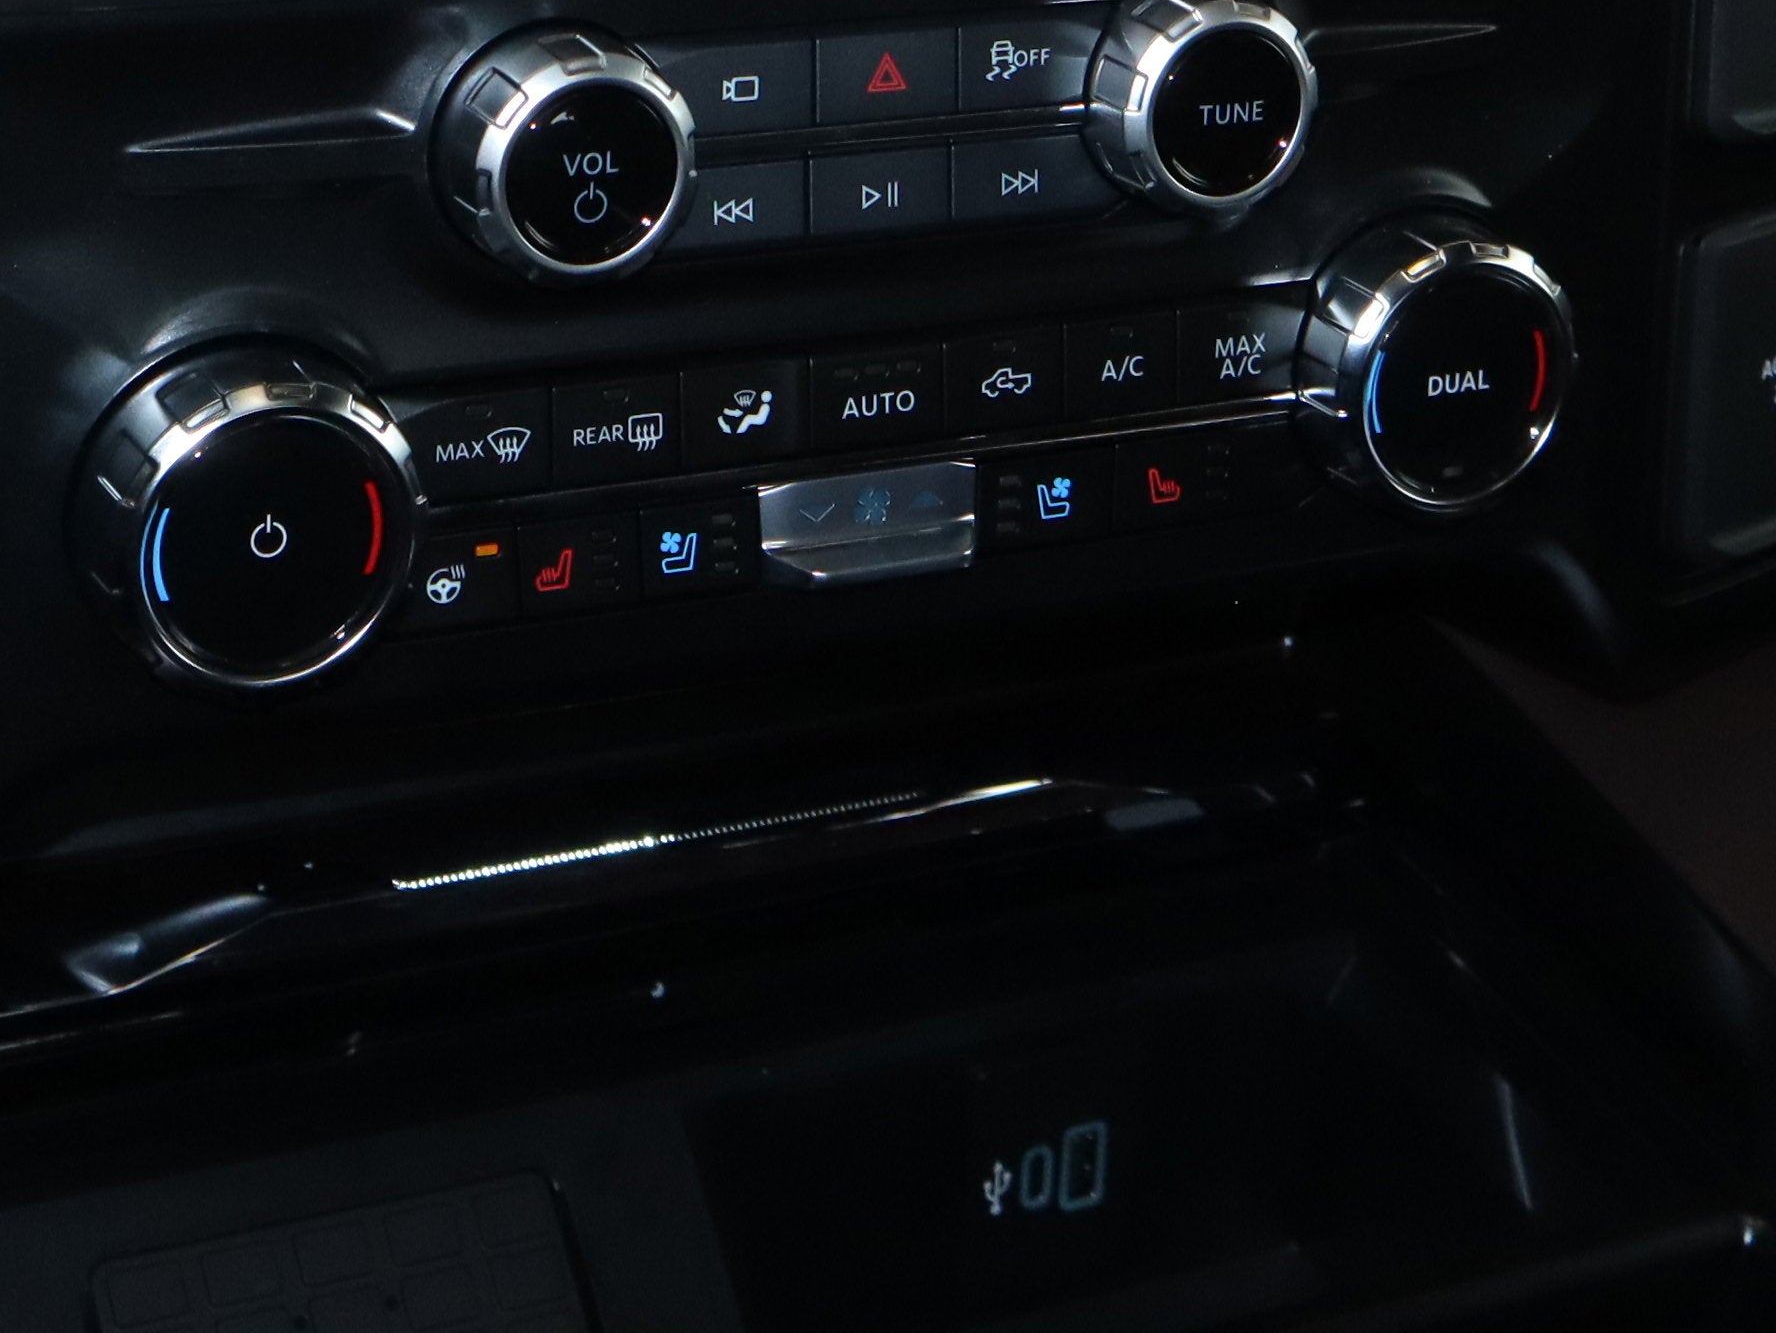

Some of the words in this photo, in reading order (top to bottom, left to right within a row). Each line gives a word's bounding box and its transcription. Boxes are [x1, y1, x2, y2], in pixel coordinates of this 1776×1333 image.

[1014, 49, 1050, 69] OFF
[1200, 100, 1264, 126] TUNE
[562, 151, 620, 175] VOL
[1215, 332, 1266, 358] MAX
[1101, 355, 1144, 382] A/C
[1220, 354, 1262, 380] A/C
[1427, 370, 1490, 398] DUAL
[843, 390, 915, 420] AUTO
[573, 424, 624, 447] REAR
[436, 442, 485, 462] MAX
